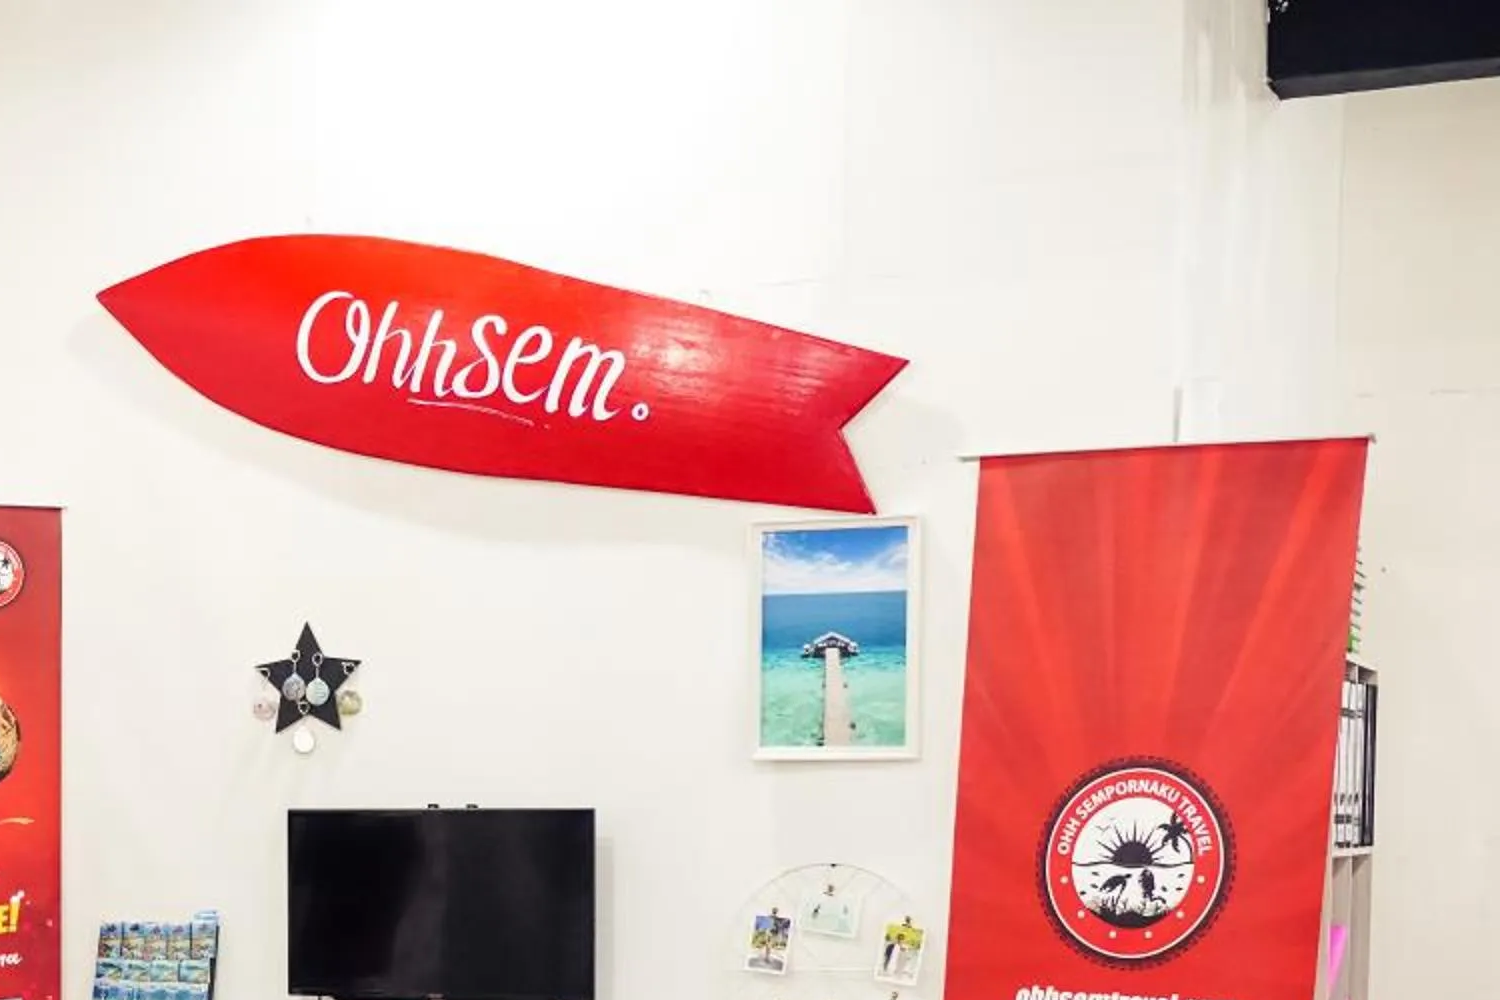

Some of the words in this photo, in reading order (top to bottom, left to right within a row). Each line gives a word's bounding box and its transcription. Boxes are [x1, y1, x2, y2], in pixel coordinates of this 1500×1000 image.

[1057, 819, 1081, 855] OHH
[1075, 780, 1181, 818] SEMPORNAKU
[1180, 796, 1213, 857] TRAVEL
